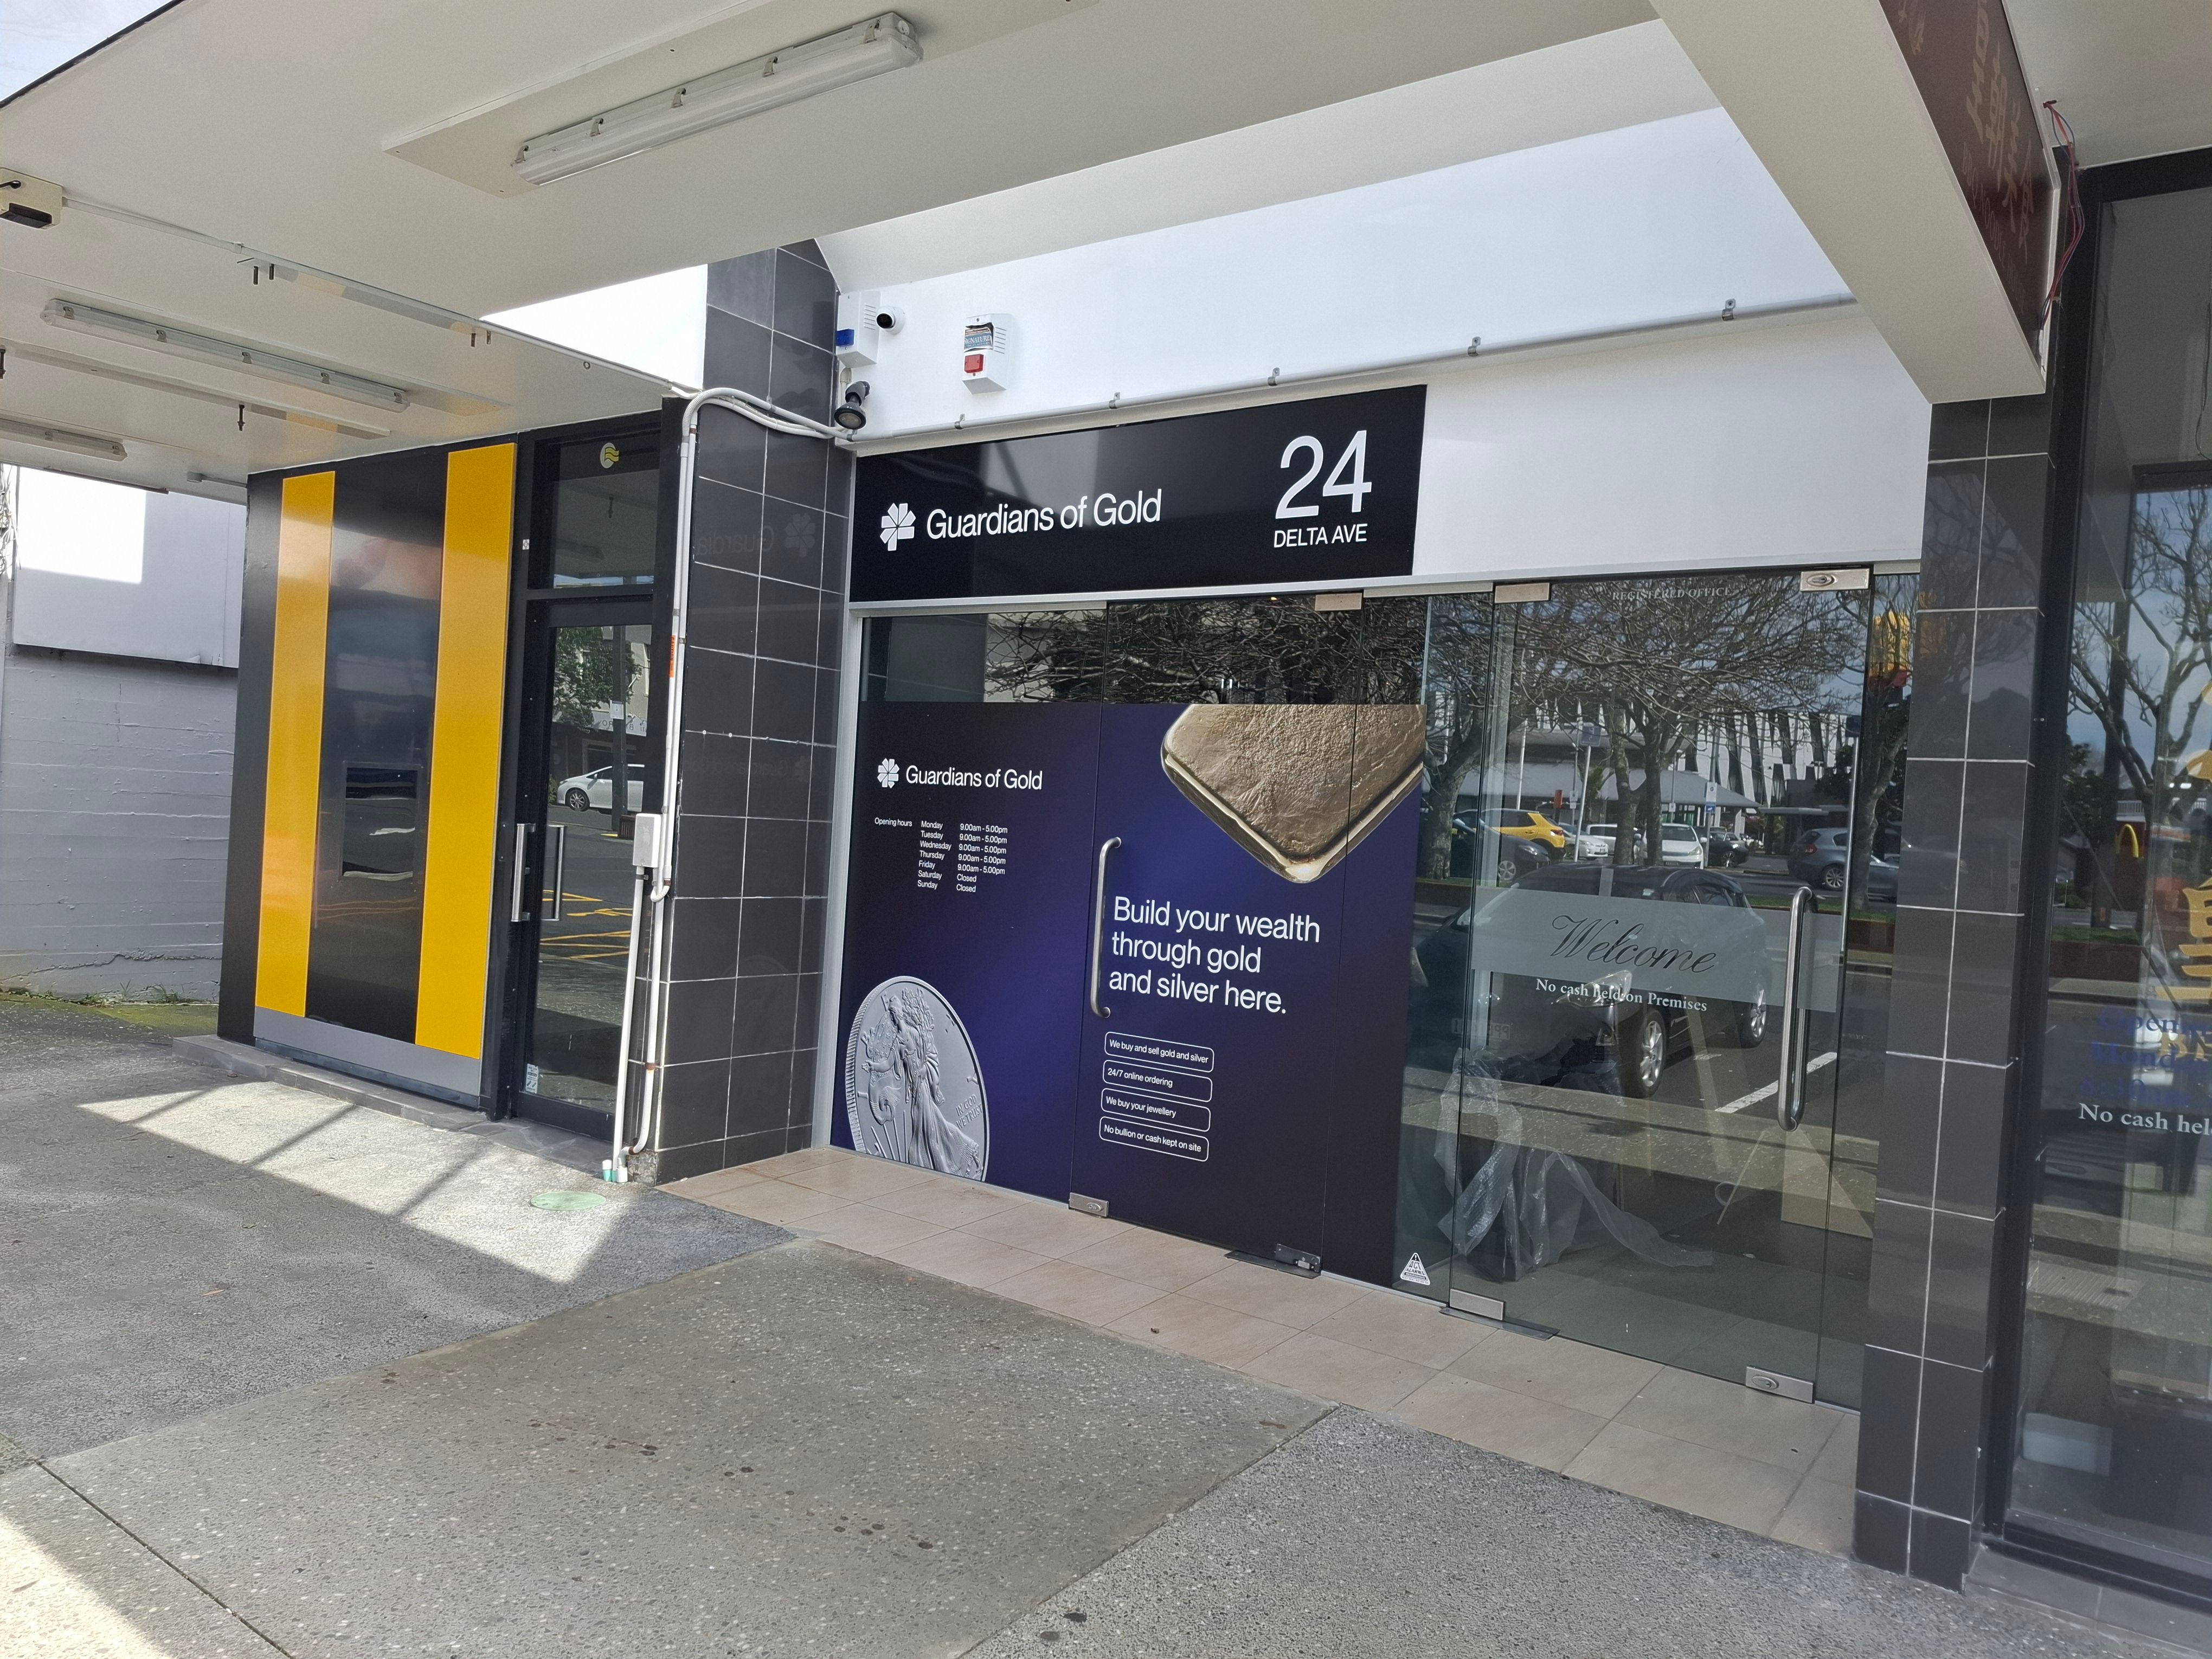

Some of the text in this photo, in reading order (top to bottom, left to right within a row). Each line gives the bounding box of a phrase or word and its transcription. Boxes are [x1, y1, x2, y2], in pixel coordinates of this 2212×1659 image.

[1276, 430, 1372, 519] 24
[927, 489, 1161, 541] Guardians of Gold
[1274, 524, 1367, 548] DELTA AVE
[1612, 587, 1732, 601] REGISTERED OFFICE
[906, 766, 1042, 789] Guardians of Gold
[875, 818, 896, 826] Opening
[922, 821, 943, 830] Monday
[986, 825, 1007, 834] 5.00pm
[919, 840, 951, 852] Wednesday
[959, 844, 980, 852] 9.00am
[985, 846, 1006, 854] 5.00pm
[921, 831, 943, 840] Tuesday
[960, 833, 980, 841] 9.00am
[985, 835, 1007, 844] 5.00pm
[919, 850, 944, 860] Thursday
[959, 854, 979, 862] 9.00am
[984, 856, 1006, 865] 5.00pm
[919, 860, 935, 870] Friday
[958, 864, 979, 872] 9.00am
[983, 866, 1005, 875] 5.00pm
[918, 870, 976, 882] Saturday Closed
[918, 880, 976, 892] Sunday Closed
[1115, 896, 1320, 942] Build your wealth
[1112, 931, 1261, 973] through gold
[1550, 915, 1716, 973] Welcome
[1109, 970, 1285, 1013] and silver here.
[1536, 979, 1707, 1012] No cash held on Premises
[1110, 1039, 1120, 1048] We
[1122, 1041, 1134, 1051] buy
[1160, 1048, 1175, 1059] gold
[1176, 1050, 1189, 1059] and
[1190, 1052, 1208, 1063] silver
[1108, 1068, 1173, 1088] 24/7 online ordering
[955, 1094, 976, 1116] IN GOD
[956, 1103, 982, 1130] WE TRUST
[1107, 1096, 1176, 1118] We buy your jewellery
[2078, 1103, 2212, 1135] No cash hel
[1104, 1124, 1114, 1133] No
[1115, 1127, 1136, 1138] bullion
[1145, 1133, 1161, 1143] cash
[1163, 1137, 1177, 1147] kept
[1189, 1143, 1201, 1152] site
